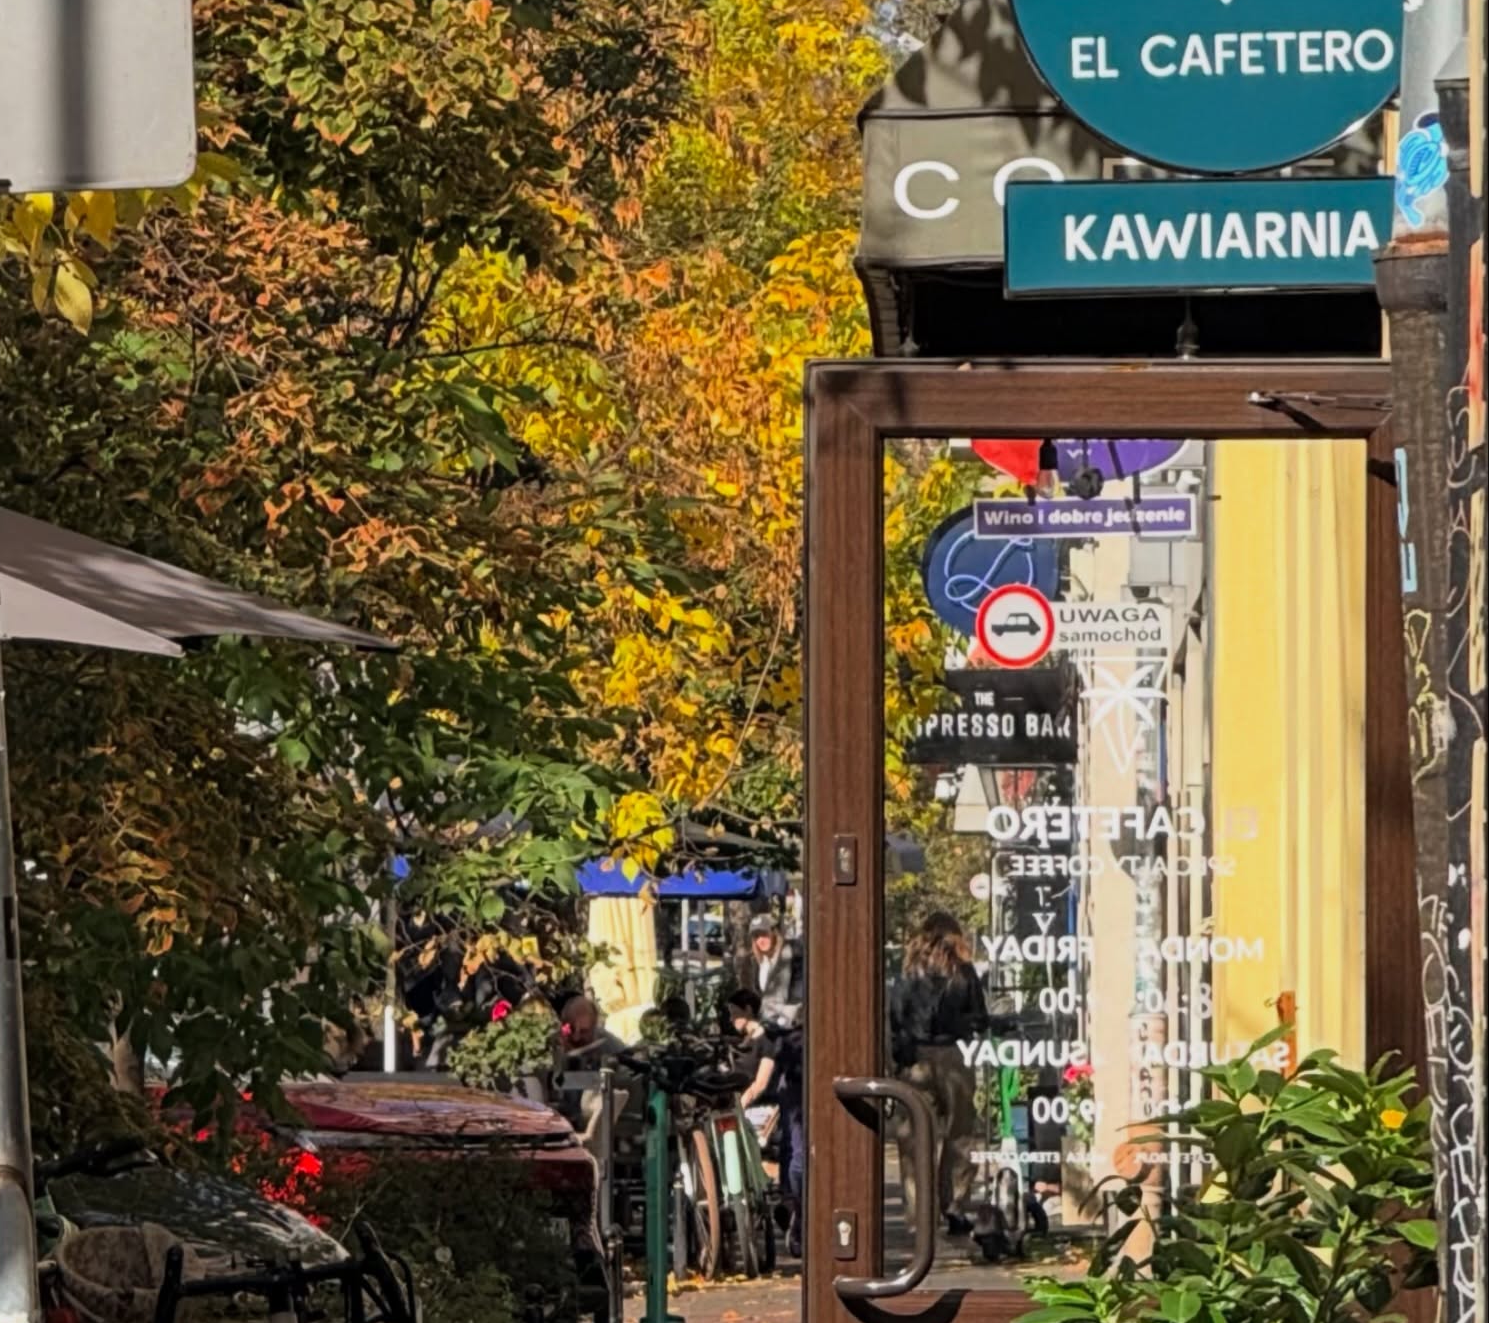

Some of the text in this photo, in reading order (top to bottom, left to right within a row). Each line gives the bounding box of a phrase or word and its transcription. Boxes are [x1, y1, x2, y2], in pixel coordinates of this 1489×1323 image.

[1071, 29, 1395, 79] EL CAFETERO
[1063, 210, 1379, 262] KAWIARNIA
[984, 510, 1034, 526] Wino
[1037, 509, 1045, 525] i
[1048, 508, 1103, 525] dobre
[1059, 607, 1160, 624] UWAGA
[1059, 626, 1162, 643] samochód
[974, 690, 995, 707] THE
[915, 712, 1015, 738] PRESSO
